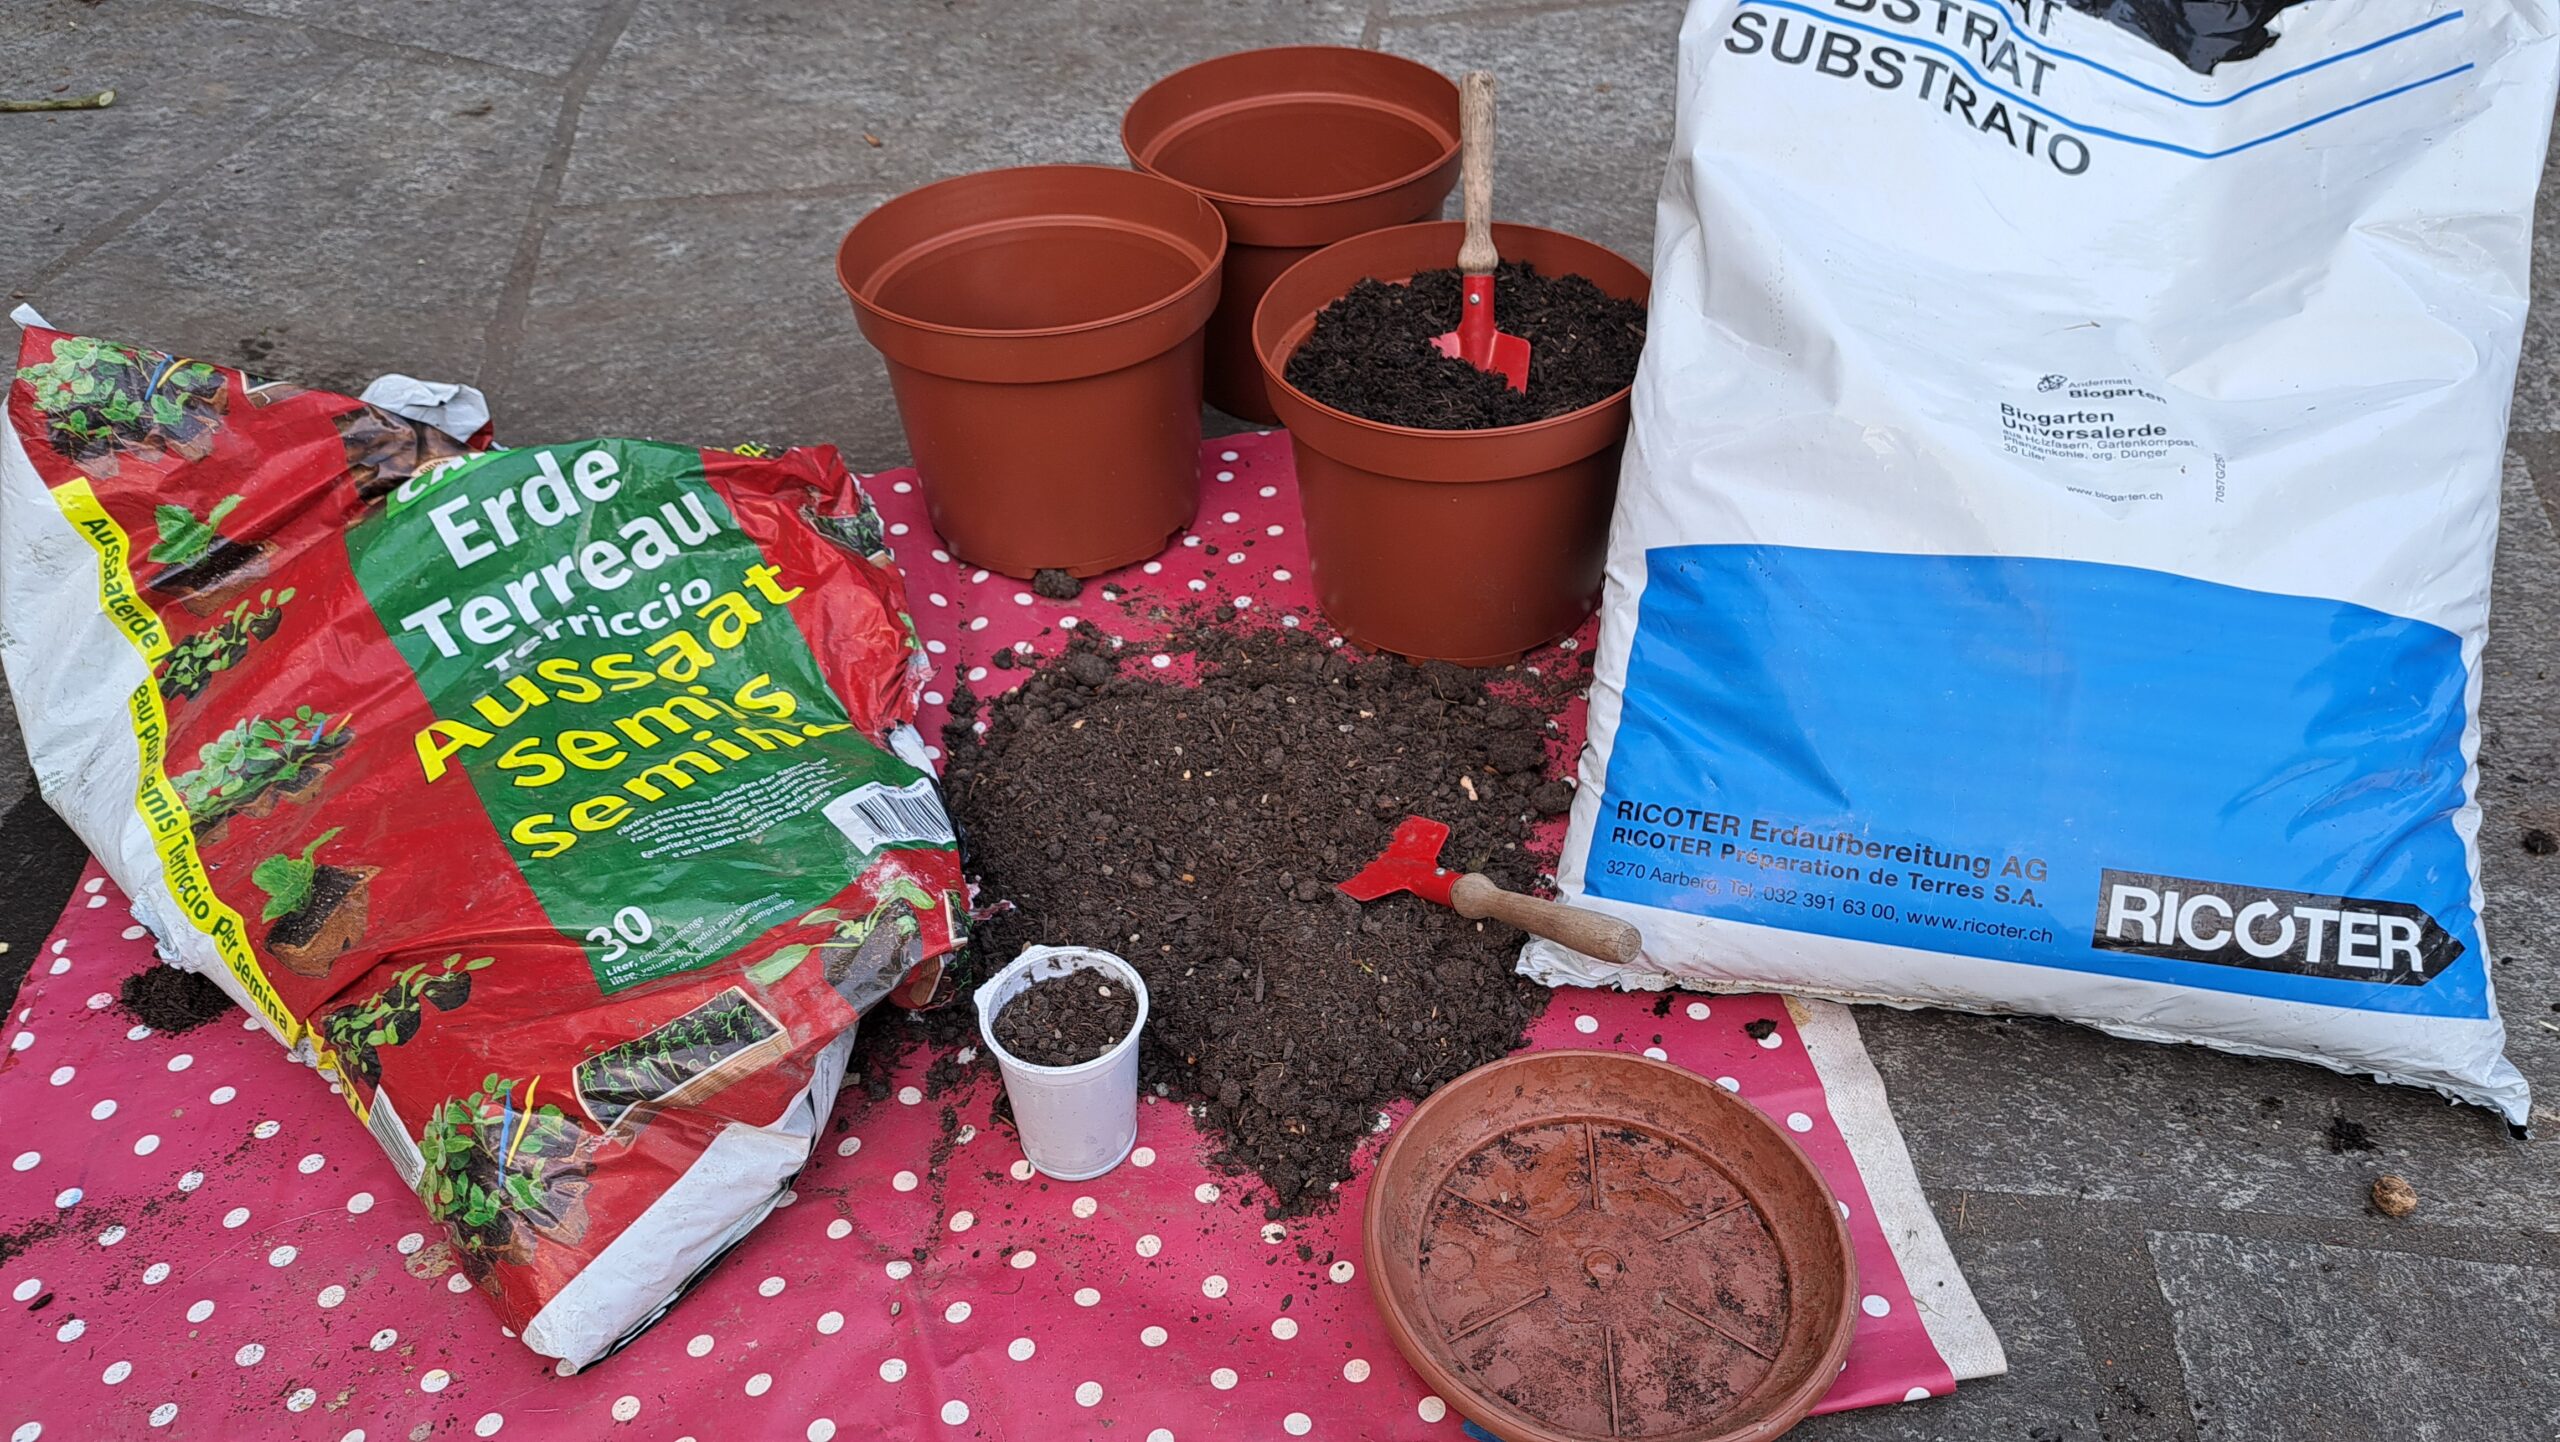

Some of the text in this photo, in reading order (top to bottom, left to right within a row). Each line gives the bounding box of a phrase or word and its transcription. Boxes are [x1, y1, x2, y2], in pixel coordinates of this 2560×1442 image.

[1723, 10, 2091, 176] SUBSTRATO
[2068, 378, 2133, 388] Andermatt
[2069, 388, 2167, 405] Biogarten
[2001, 402, 2115, 427] Biogarten
[2002, 415, 2167, 440] Universalerde
[2004, 443, 2046, 461] 30 Liter
[2092, 452, 2117, 461] org.
[2121, 449, 2168, 460] Dünger
[427, 449, 622, 569] Erde
[80, 518, 160, 648] Aussaaterde
[400, 491, 722, 659] Terreau
[483, 578, 712, 673] Terriccio
[133, 680, 155, 723] eau
[413, 562, 806, 784] Aussaat
[496, 672, 798, 788] semis
[141, 768, 183, 833] emis
[656, 807, 675, 817] das
[758, 775, 776, 786] der
[747, 787, 764, 798] der
[804, 772, 817, 780] et
[681, 847, 701, 856] una
[701, 836, 736, 851] buona
[736, 820, 775, 840] crescita
[776, 809, 801, 822] delle
[801, 790, 831, 813] piante
[692, 834, 707, 843] un
[785, 793, 808, 810] delle
[740, 808, 759, 821] des
[1616, 800, 2048, 882] RICOTER Erdaufbereitung AG
[1611, 827, 2043, 908] RICOTER Préparation de Terres S.A.
[694, 934, 732, 963] prodotto
[731, 922, 748, 937] non
[748, 899, 795, 924] compresso
[1606, 860, 1646, 878] 3270
[1649, 867, 1722, 895] Aarberg,
[1763, 887, 1798, 905] 032
[1803, 892, 1835, 912] 391
[1843, 899, 1866, 916] 63
[1872, 903, 1899, 923] 00,
[1907, 911, 2053, 944] www.ricoter.ch
[2106, 883, 2424, 973] RICOTER
[168, 835, 288, 1034] Terriccio per semina
[585, 905, 653, 962] 30
[606, 916, 705, 976] Liter, Entnahmemenge
[641, 955, 676, 973] volume
[676, 946, 689, 958] du
[687, 925, 719, 950] produit
[717, 913, 735, 928] non
